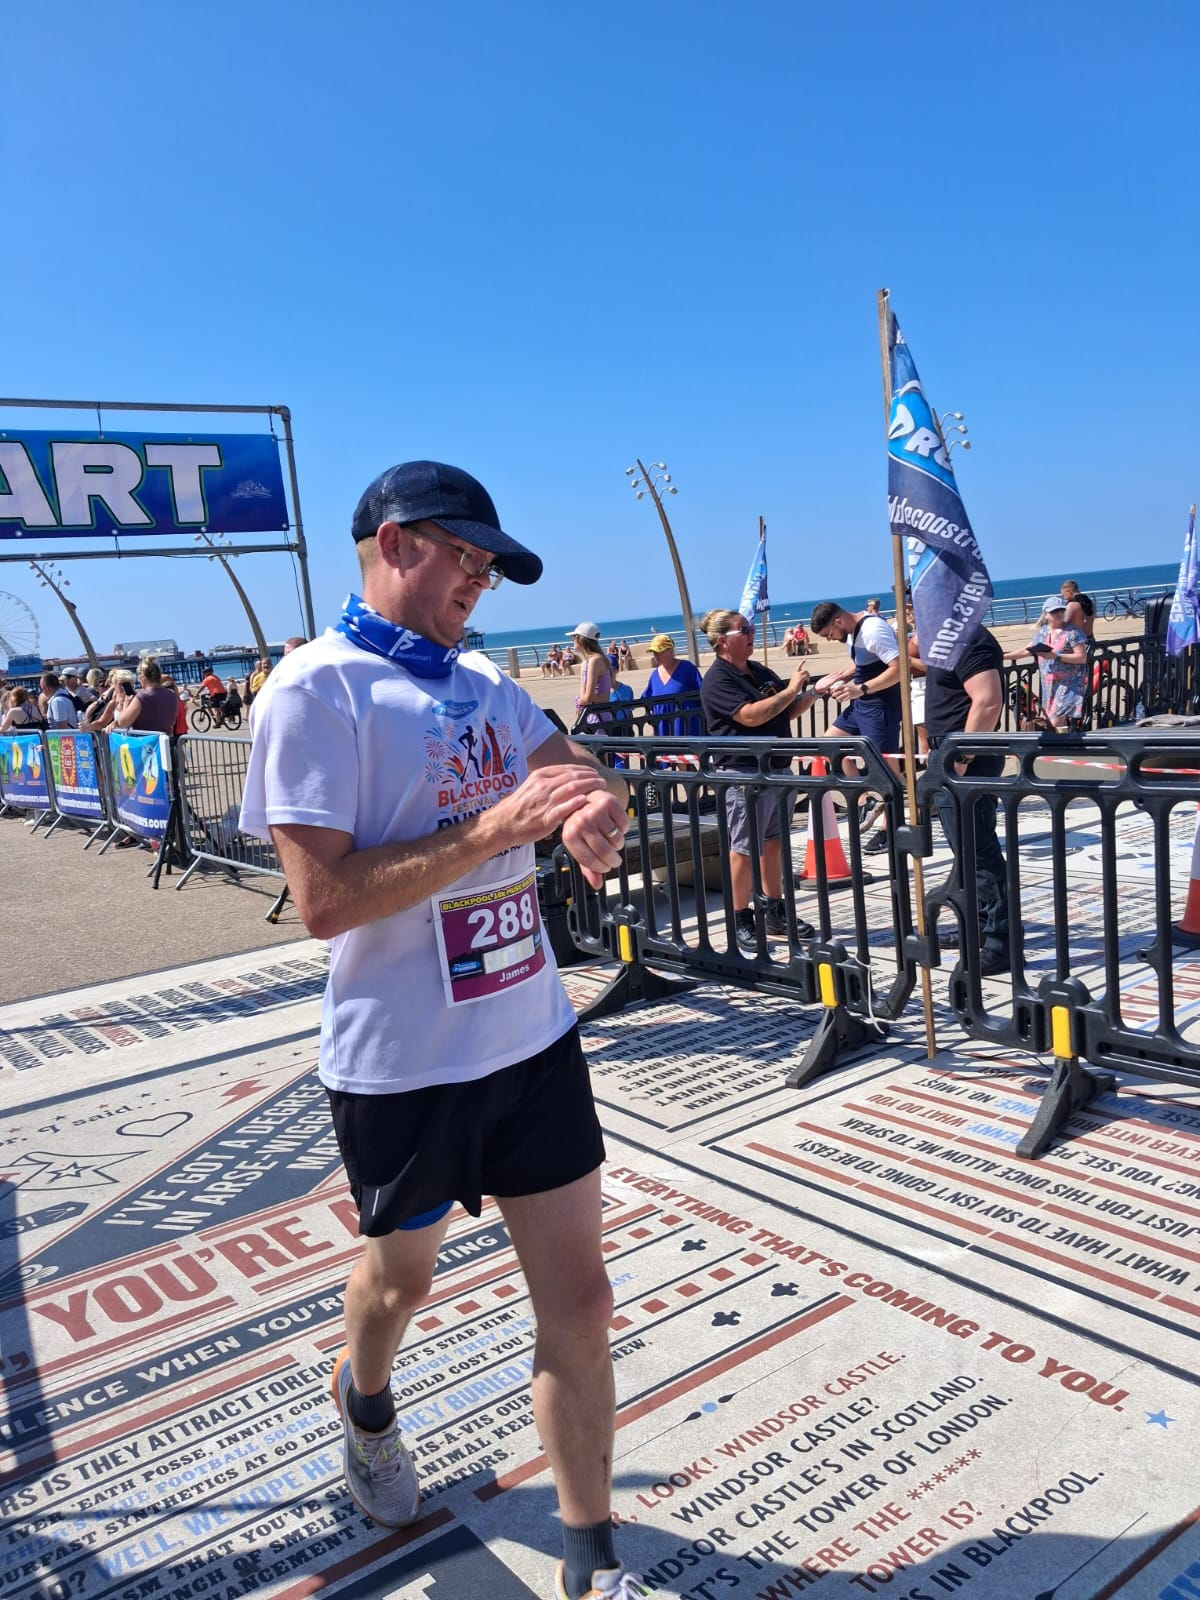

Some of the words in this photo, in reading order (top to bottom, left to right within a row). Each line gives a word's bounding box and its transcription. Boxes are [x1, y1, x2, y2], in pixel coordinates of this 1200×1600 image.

[451, 795, 495, 815] FESTIVAL
[442, 894, 491, 912] BLACKPOOL
[467, 893, 534, 949] 288
[499, 963, 530, 983] James
[616, 1061, 668, 1081] BRACE
[652, 1066, 685, 1080] AND
[662, 1060, 740, 1089] SMASHING
[717, 1068, 758, 1085] THEY
[644, 1086, 665, 1097] AT
[655, 1081, 720, 1107] HAVEN'T
[912, 1078, 960, 1096] MUST
[235, 1083, 326, 1134] DEGREE
[682, 1091, 734, 1110] WHEN
[866, 1094, 901, 1108] YOU
[895, 1101, 921, 1115] DO
[837, 1117, 895, 1139] SPEAK
[917, 1108, 969, 1128] WHAT
[219, 1138, 260, 1150] A
[793, 1138, 841, 1163] EASY.
[889, 1132, 916, 1147] TO
[909, 1139, 945, 1156] ME
[167, 1150, 239, 1185] GOT
[831, 1149, 859, 1167] BE
[853, 1159, 883, 1175] TO
[934, 1149, 1001, 1174] ALLOW
[876, 1167, 938, 1193] GOING
[993, 1167, 1052, 1190] ONCE
[1117, 1166, 1165, 1187] YOU
[1045, 1182, 1100, 1207] THIS
[103, 1190, 186, 1226] I'VE
[977, 1202, 1024, 1225] SAY
[1095, 1198, 1144, 1220] FOR
[152, 1210, 212, 1232] IN
[1016, 1216, 1053, 1235] TO
[1045, 1226, 1111, 1255] HAVE
[1103, 1246, 1123, 1260] I
[32, 1216, 335, 1343] YOU'RE
[1115, 1252, 1191, 1286] WHAT
[607, 1167, 753, 1235] EVERYTHING
[748, 1228, 849, 1278] THAT'S
[843, 1272, 980, 1340] COMING
[980, 1331, 1036, 1364] TO
[1037, 1357, 1130, 1412] YOU.
[0, 1379, 129, 1440] ILENCE
[136, 1335, 242, 1384] WHEN
[215, 1413, 284, 1450] INNIT?
[289, 1390, 333, 1416] COM
[391, 1346, 435, 1372] LET'S
[436, 1328, 478, 1352] STAB
[479, 1309, 521, 1332] HIM!
[41, 1473, 72, 1497] IS
[73, 1441, 142, 1480] THEY
[148, 1394, 255, 1452] ATTRACT
[255, 1357, 338, 1403] FOREIG
[94, 1490, 150, 1523] BLUE
[154, 1442, 262, 1495] FOOTBALL
[263, 1411, 331, 1446] SOCKS.
[390, 1353, 453, 1388] THOUGH
[454, 1333, 498, 1358] THEY
[105, 1466, 240, 1535] SYNTHETICS
[244, 1453, 270, 1472] AT
[274, 1440, 298, 1458] 60
[301, 1418, 342, 1444] DEG
[392, 1373, 446, 1402] COULD
[450, 1352, 489, 1375] COST
[491, 1337, 525, 1355] YOU
[635, 1456, 719, 1509] LOOK!
[715, 1395, 827, 1459] WINDSOR
[823, 1351, 906, 1397] CASTLE.
[670, 1451, 793, 1524] WINDSOR
[790, 1396, 880, 1453] CASTLE?
[735, 1457, 844, 1529] CASTLE'S
[839, 1438, 875, 1461] IN
[870, 1375, 984, 1442] SCOTLAND.
[92, 1532, 185, 1581] WELL,
[182, 1504, 232, 1537] WE
[230, 1471, 304, 1515] HOPE
[301, 1452, 341, 1482] HE
[398, 1402, 446, 1435] HEY
[444, 1365, 526, 1412] BURIED
[268, 1502, 358, 1552] SMELLY
[416, 1437, 492, 1481] ANIMAL
[491, 1411, 534, 1440] KEE
[737, 1530, 800, 1571] THE
[793, 1473, 888, 1533] TOWER
[883, 1450, 918, 1476] OF
[914, 1393, 1013, 1455] LONDON.
[168, 1540, 235, 1580] THAT
[240, 1498, 323, 1544] YOU'VE
[929, 1562, 973, 1594] IN
[962, 1470, 1105, 1568] BLACKPOOL.
[756, 1536, 862, 1600] WHERE
[852, 1501, 913, 1540] THE
[848, 1525, 949, 1595] TOWER
[940, 1500, 983, 1533] IS?
